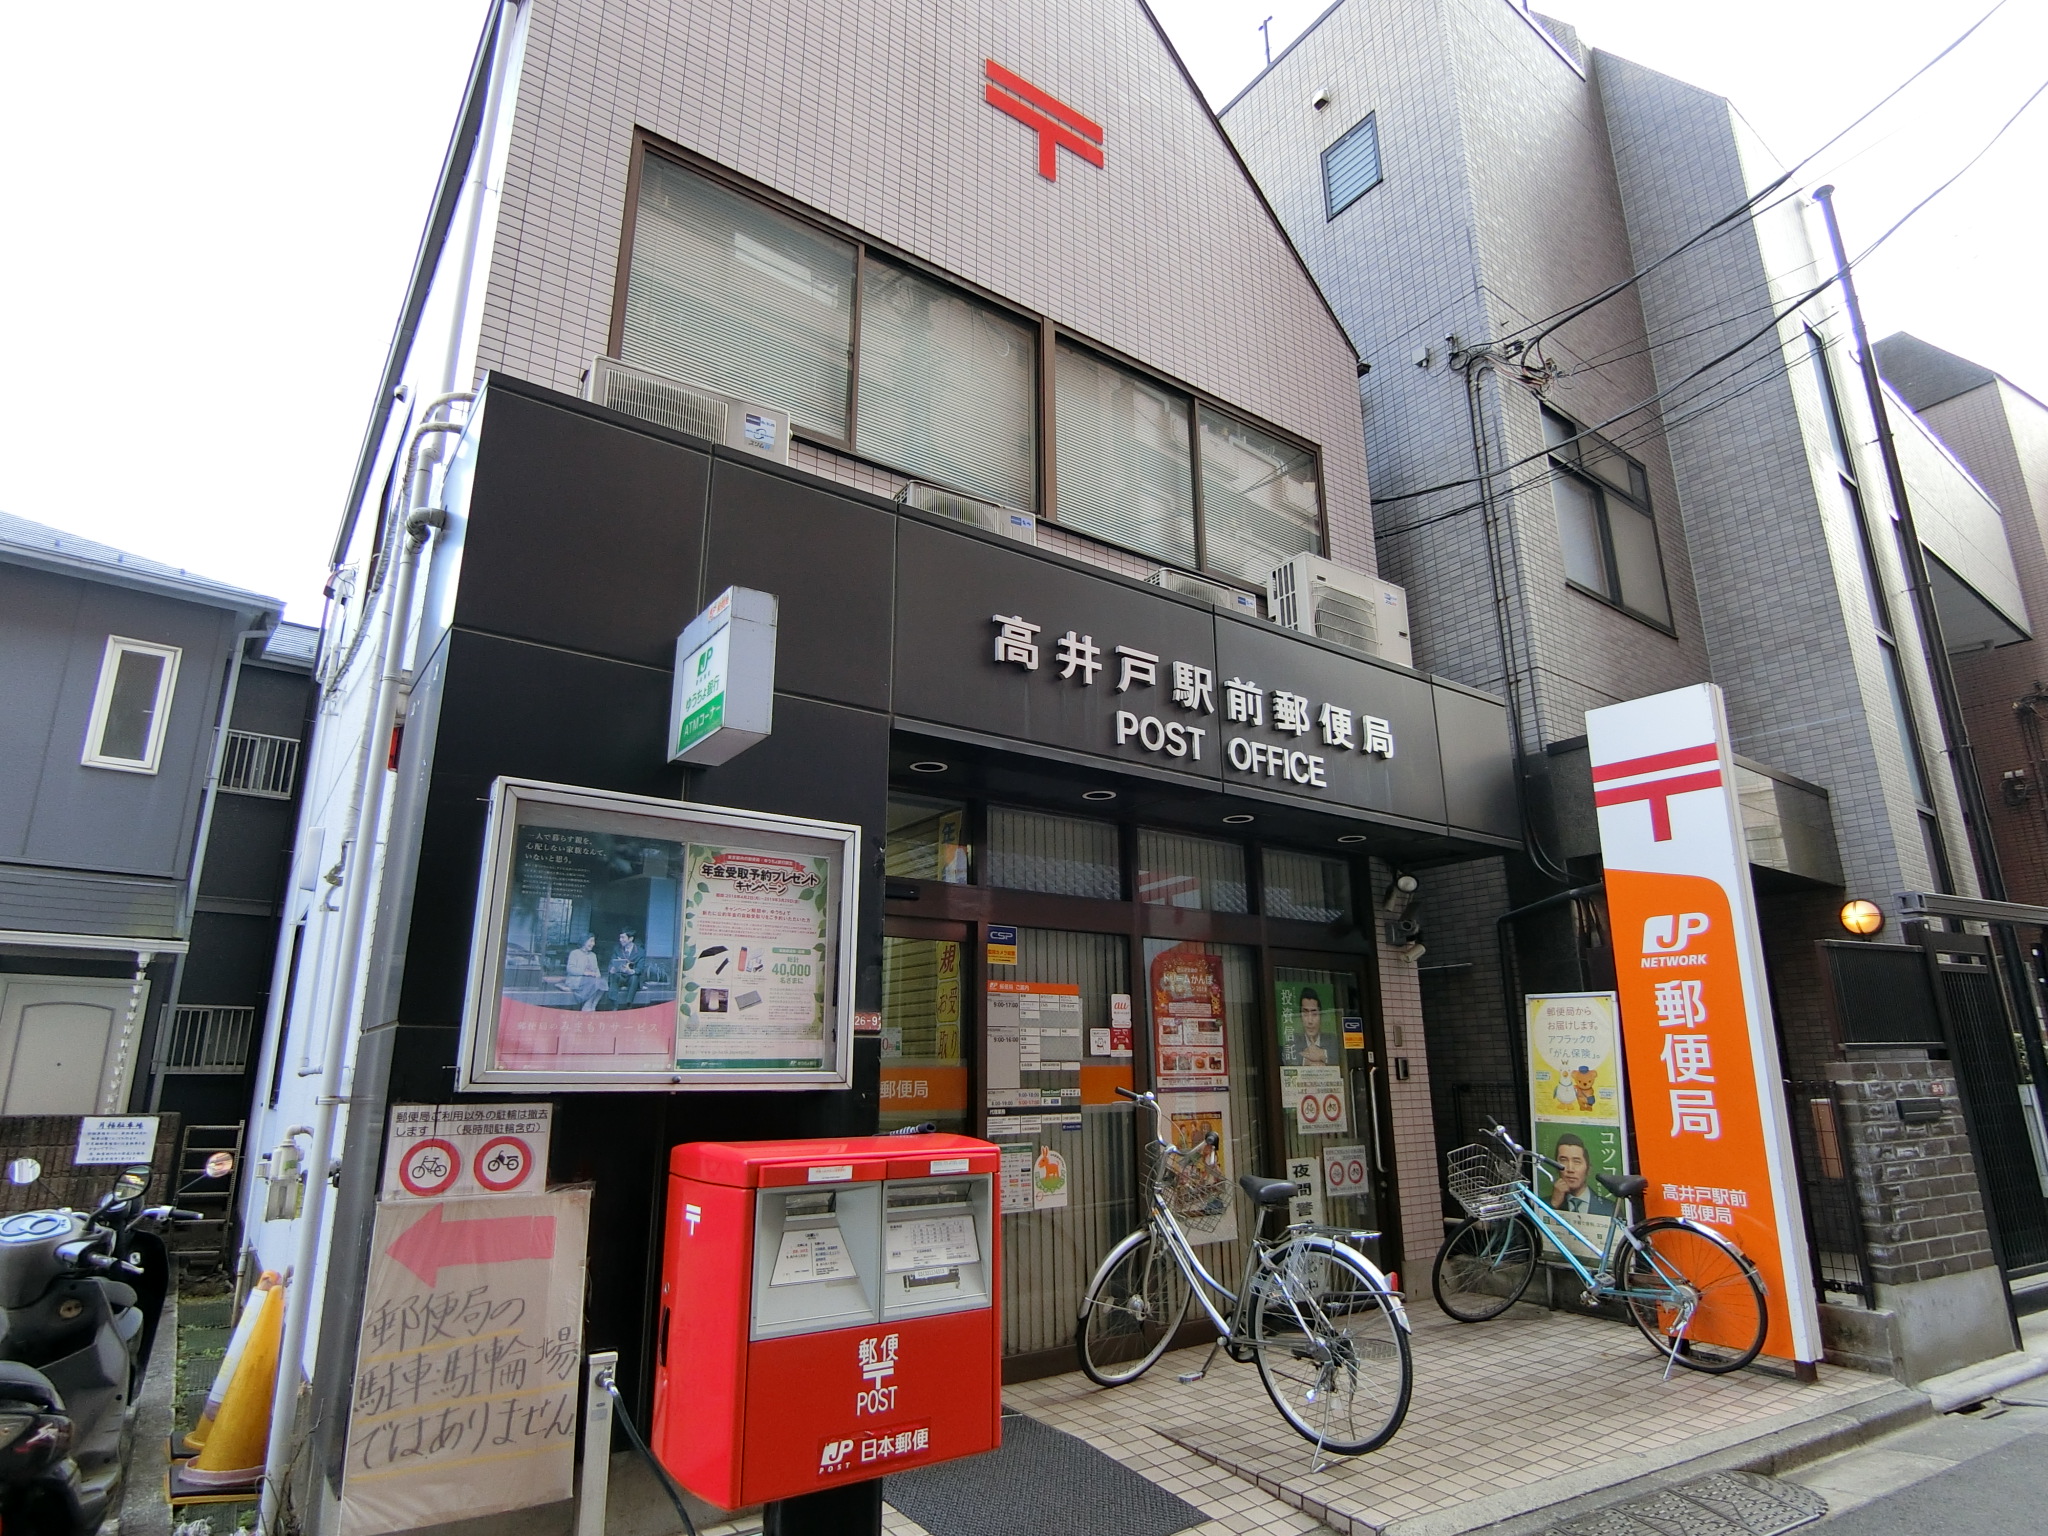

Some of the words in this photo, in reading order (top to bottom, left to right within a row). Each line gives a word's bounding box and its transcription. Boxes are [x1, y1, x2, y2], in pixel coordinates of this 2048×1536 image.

[685, 675, 720, 713] ゆうちょ銀行
[992, 614, 1395, 760] 高井戸駅前郵便局
[684, 705, 722, 736] ATMコーナー
[1116, 710, 1206, 762] POST
[1228, 737, 1327, 788] OFFICE
[525, 853, 573, 864] いないと思う。
[701, 864, 820, 887] 年金受取予約プレゼント
[735, 880, 788, 894] キャンペーン
[990, 931, 1014, 940] CSP
[1642, 912, 1710, 954] JP
[772, 963, 811, 977] 40,000
[1641, 953, 1708, 969] NETWORK
[780, 977, 804, 985] 名さまに
[1114, 1002, 1128, 1010] au
[1546, 1006, 1592, 1017] 郵便局から
[518, 1021, 659, 1034] 郵便局のみまもりサービス
[1281, 989, 1297, 1061] 投資信託
[1547, 1020, 1599, 1031] お届けします。
[1548, 1035, 1596, 1045] アフラックの
[1549, 1048, 1601, 1060] 「がん保険」。
[1654, 979, 1721, 1141] 郵便局
[880, 1079, 929, 1099] 郵便局
[396, 1109, 548, 1123] 郵便局ご利用以外の駐輪は撤去
[396, 1126, 429, 1137] します
[1601, 1132, 1617, 1198] コツコ
[1661, 1183, 1747, 1208] 高井戸駅前
[1680, 1203, 1732, 1225] 郵便局
[367, 1285, 526, 1353] 郵便局の
[858, 1333, 899, 1367] 郵便
[856, 1386, 898, 1417] POST
[821, 1438, 854, 1466] JP
[861, 1427, 930, 1463] 日本郵便
[818, 1461, 852, 1475] POST
